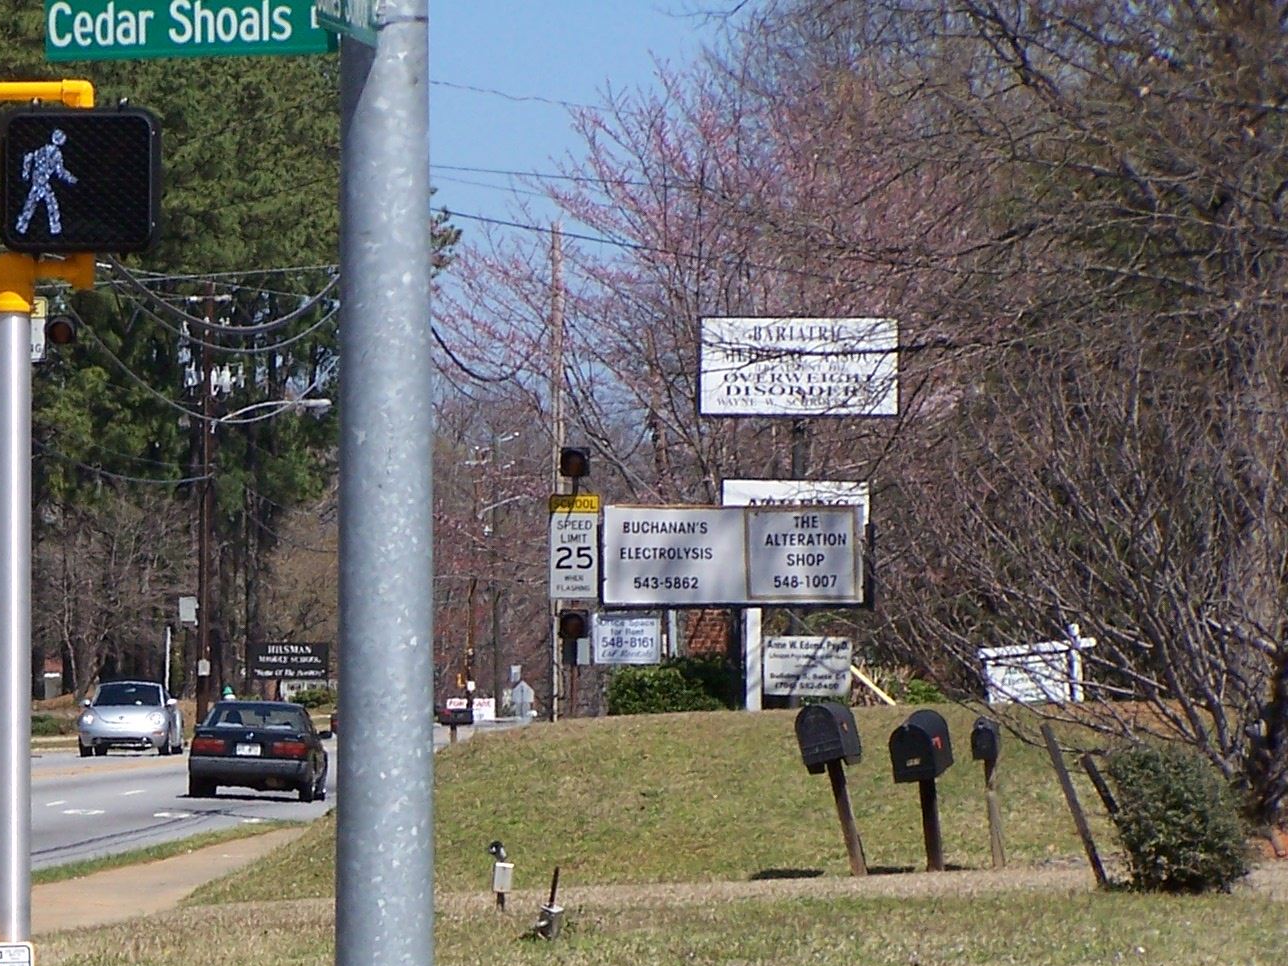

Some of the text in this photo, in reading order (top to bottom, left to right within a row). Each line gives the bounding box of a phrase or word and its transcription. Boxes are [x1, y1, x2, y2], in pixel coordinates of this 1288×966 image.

[48, 0, 153, 47] Cedar
[168, 0, 292, 44] Shoals
[554, 498, 596, 510] SCHOOL
[556, 519, 593, 531] SPEED
[622, 521, 709, 534] BUCHANAN'S
[793, 515, 819, 529] THE
[560, 533, 588, 544] LIMIT
[764, 533, 847, 547] ALTERATION
[555, 546, 594, 570] 25
[620, 547, 713, 560] ELECTROLYSIS
[786, 553, 825, 567] SHOP
[633, 576, 699, 590] 543-5862
[773, 575, 838, 589] 548-1007
[601, 636, 654, 649] 548-8161
[268, 645, 312, 654] HILSMAN
